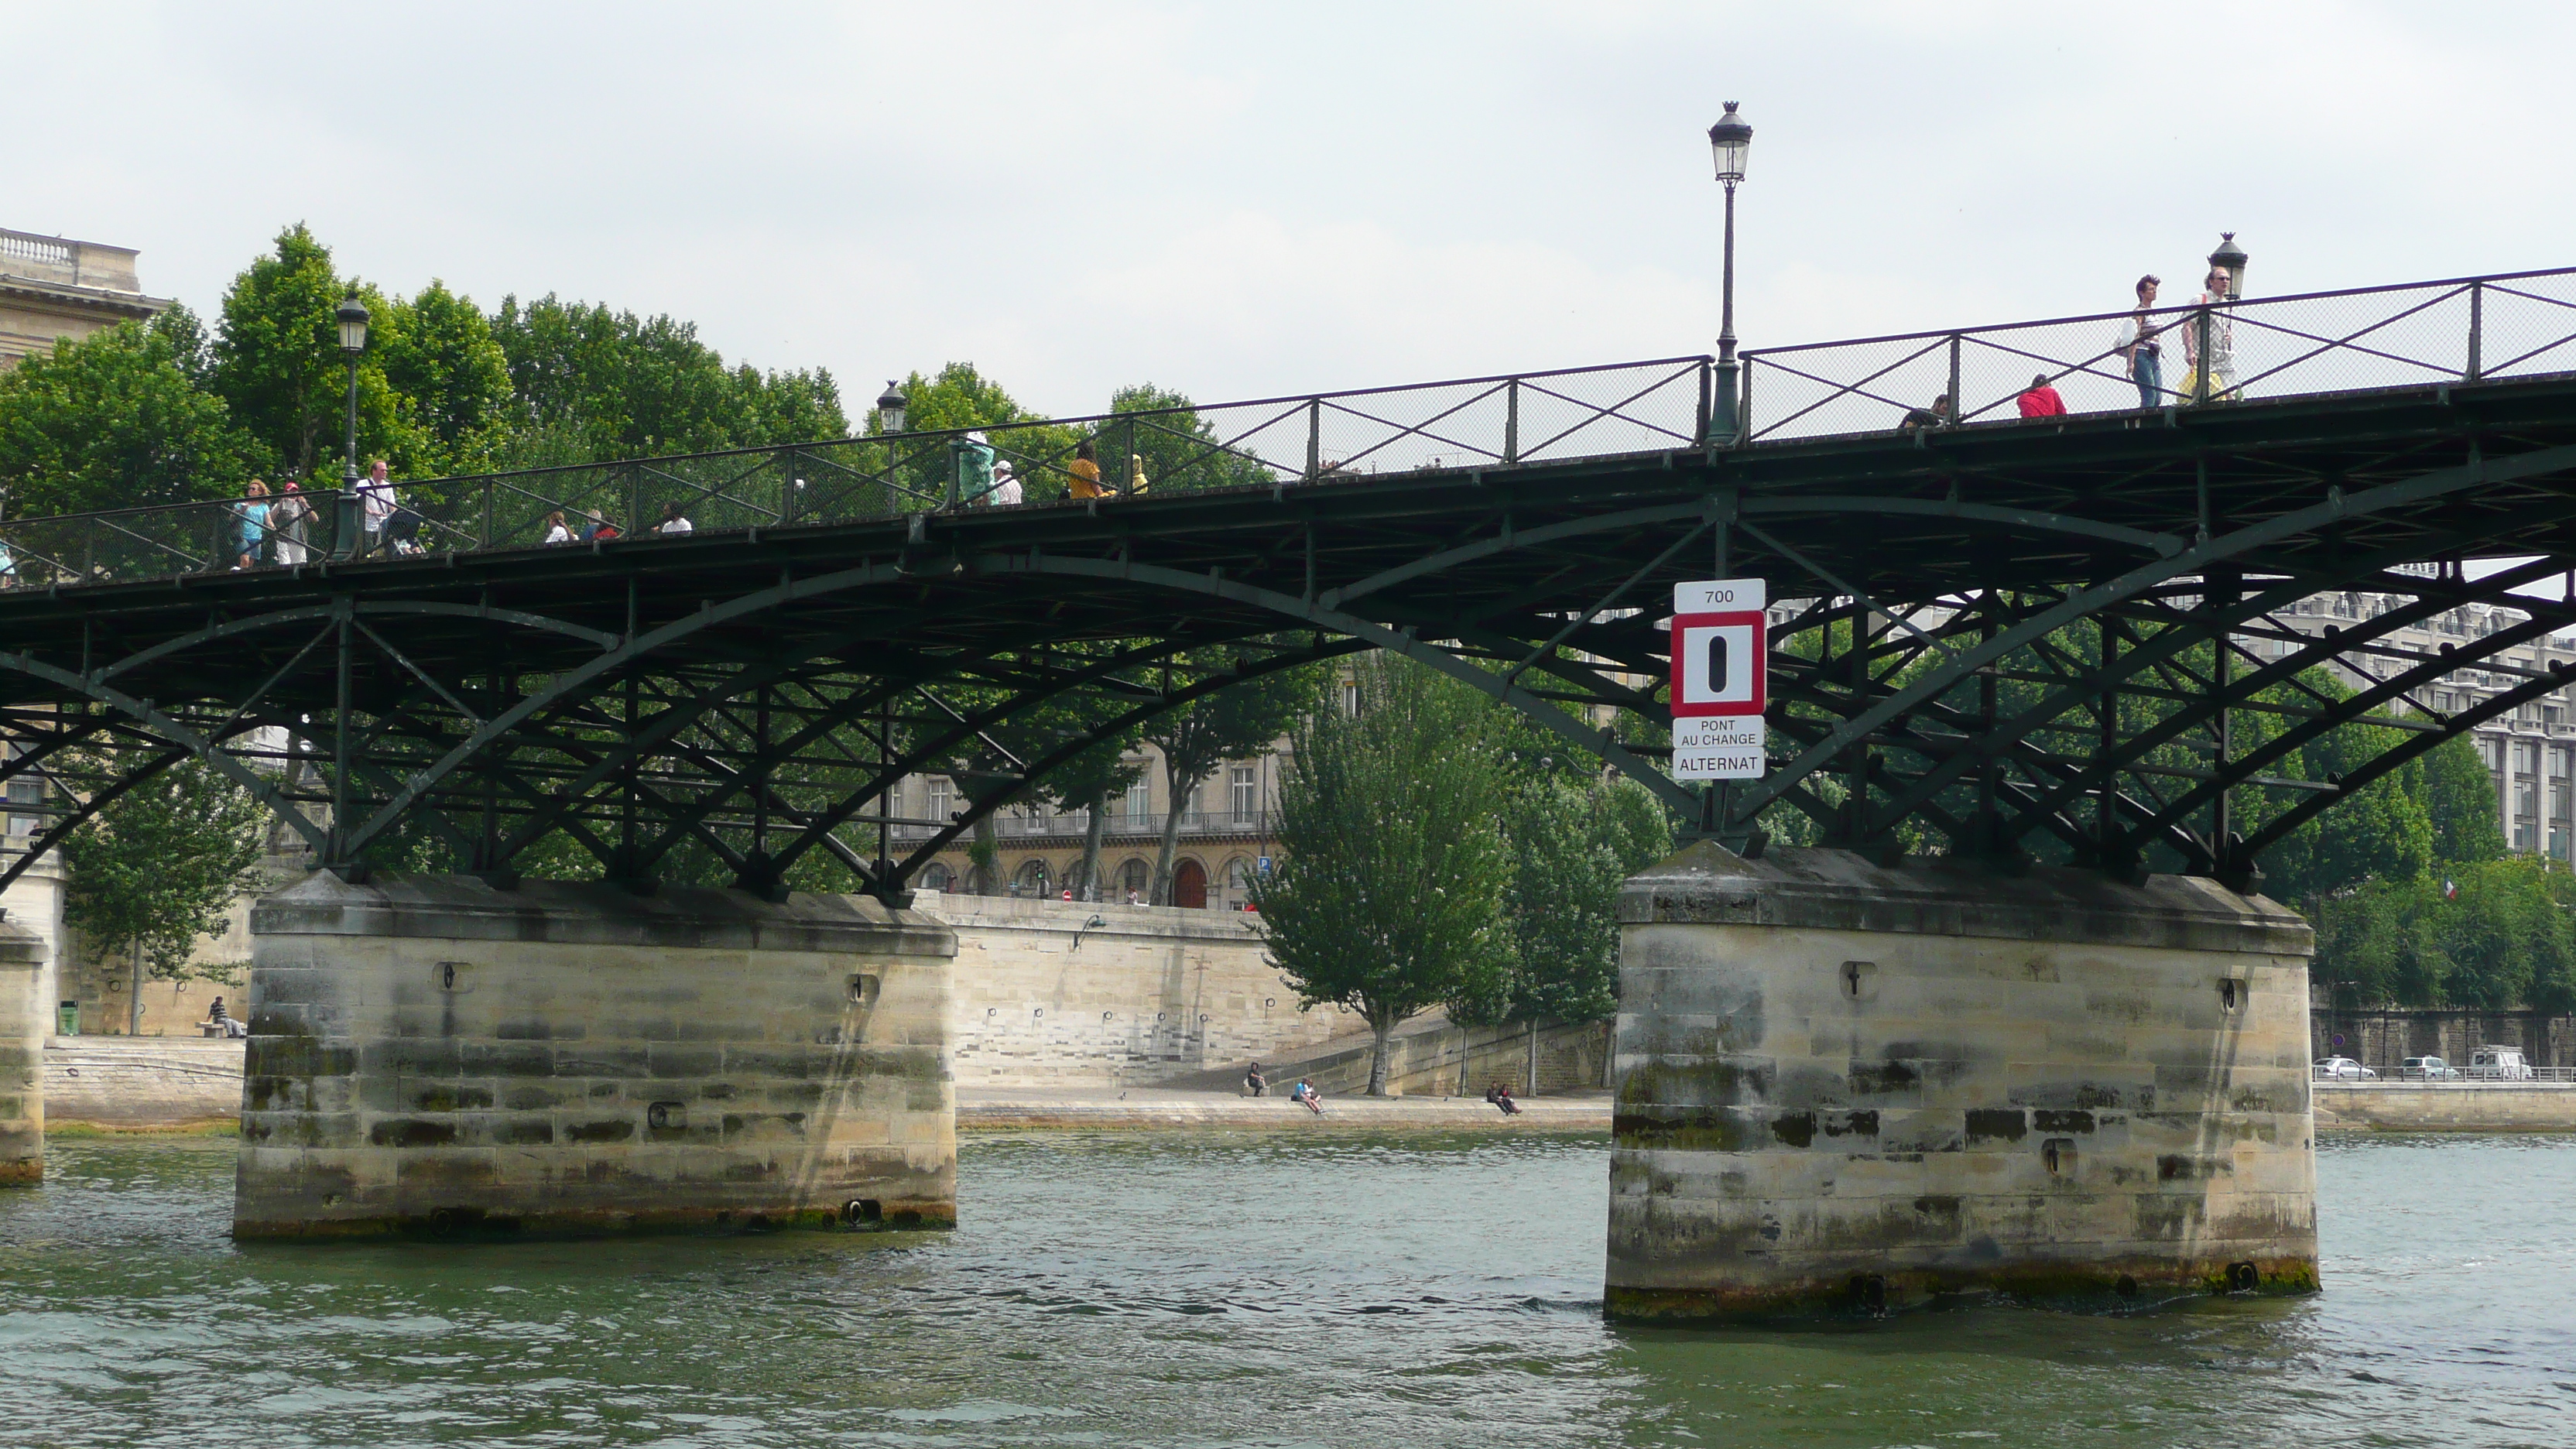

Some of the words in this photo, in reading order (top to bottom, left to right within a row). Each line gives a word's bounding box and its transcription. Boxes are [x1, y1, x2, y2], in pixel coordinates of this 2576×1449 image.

[1704, 590, 1734, 604] 700
[1701, 720, 1735, 731] PONT
[1681, 735, 1698, 746] AU
[1702, 733, 1756, 745] CHANGE
[1679, 756, 1758, 772] ALTERNAT
